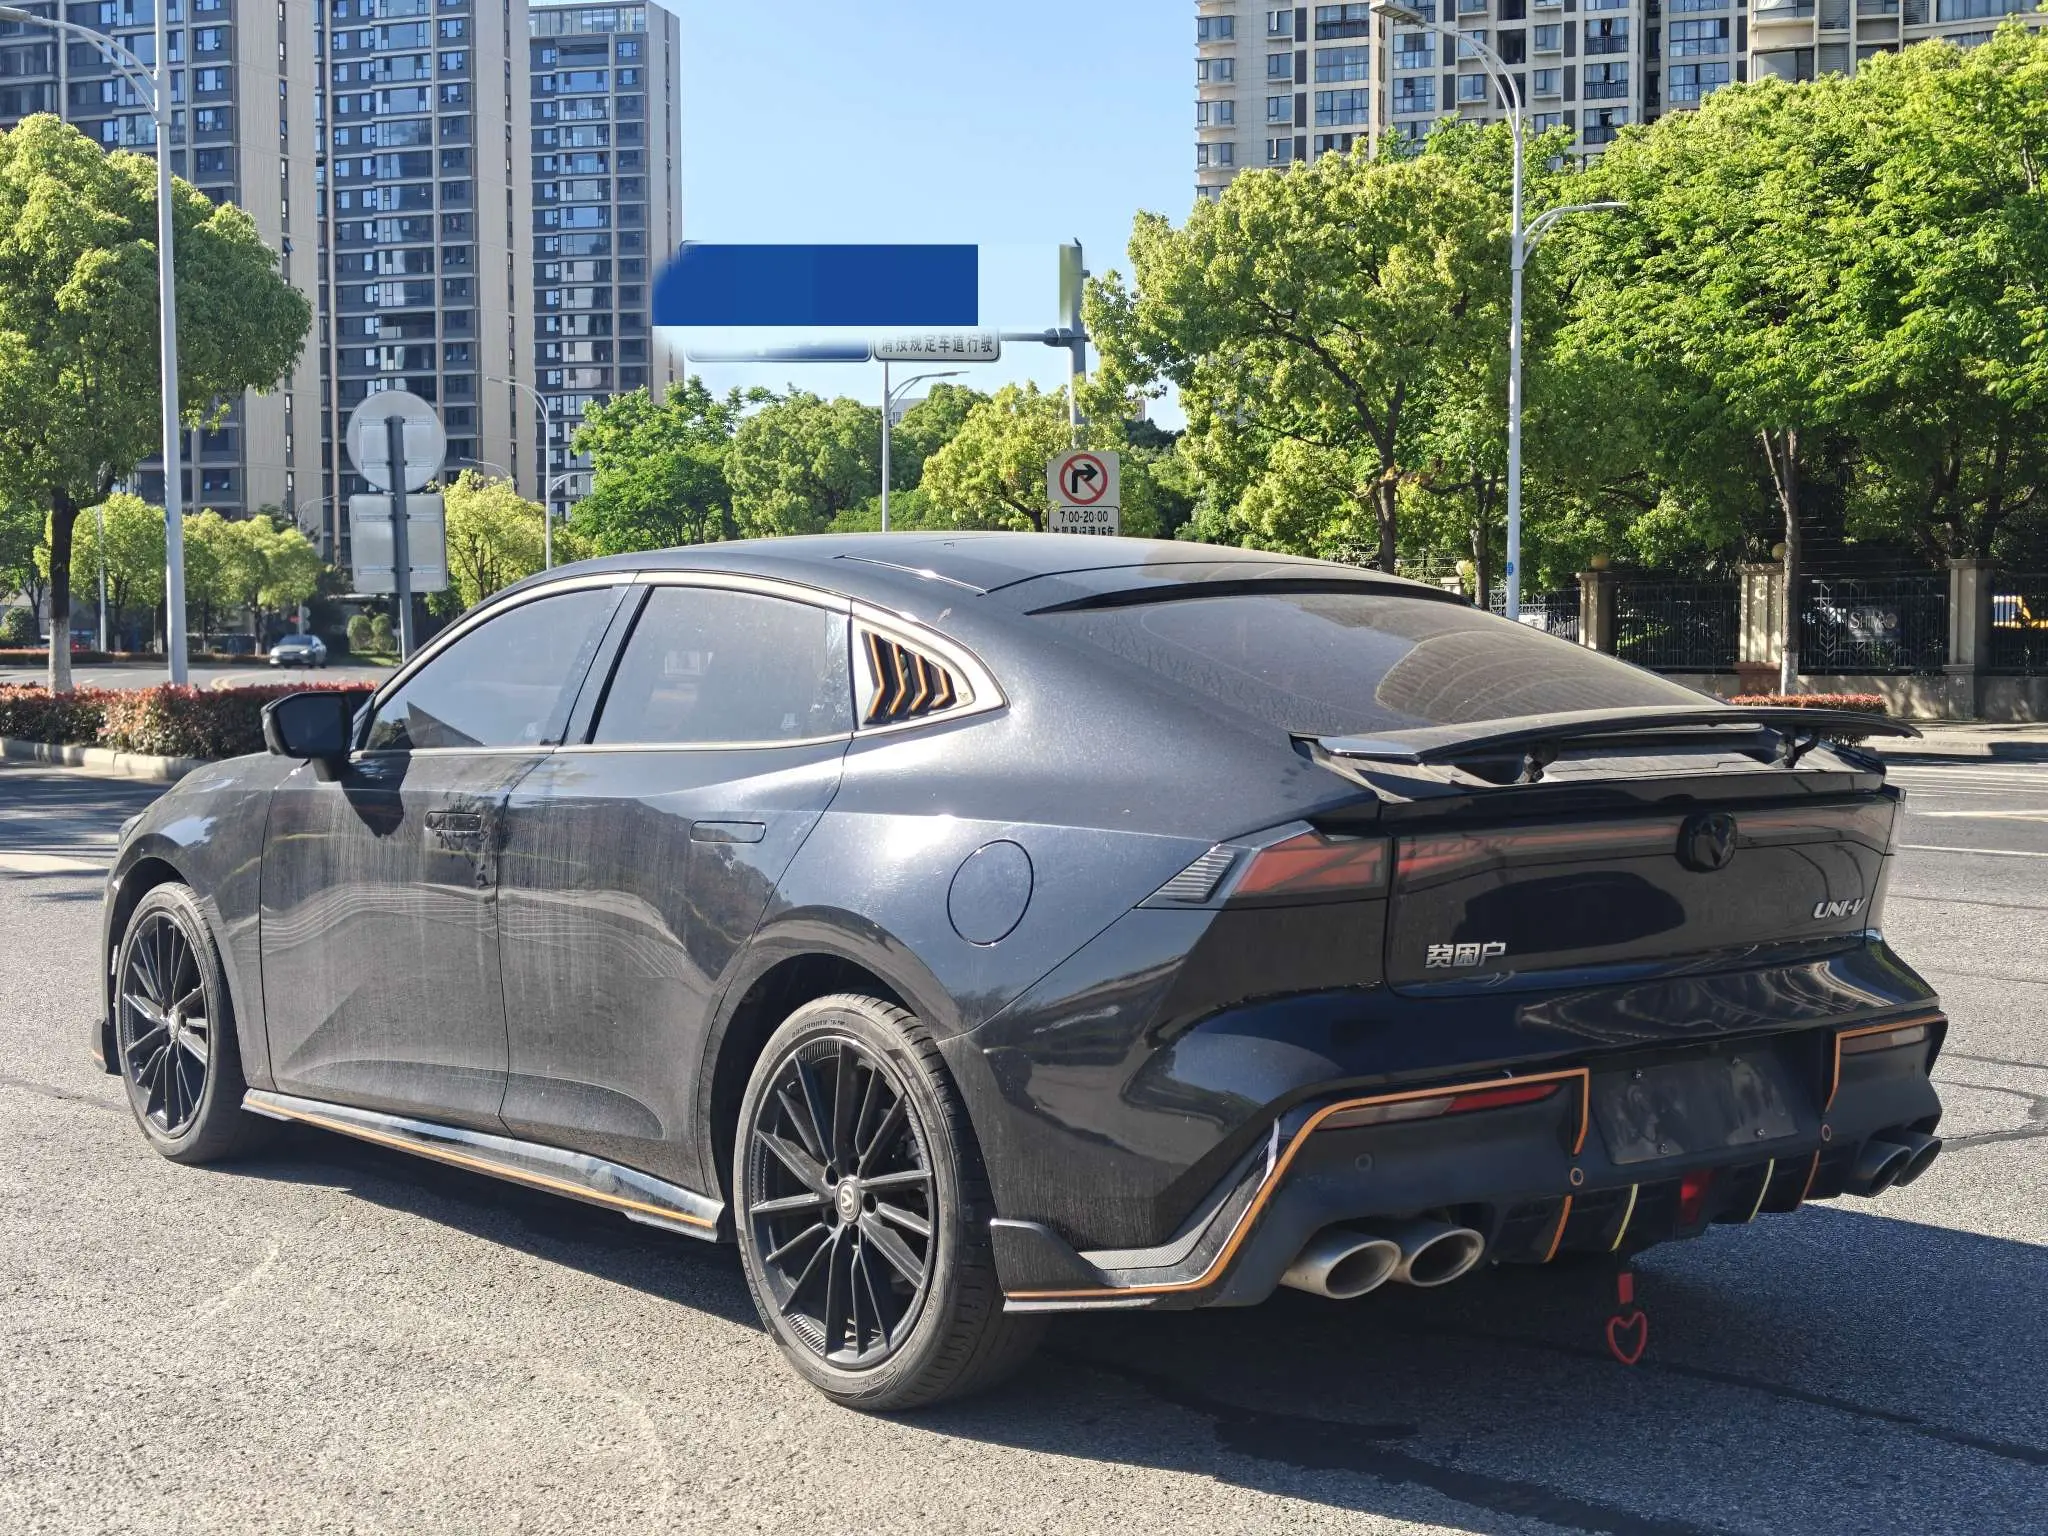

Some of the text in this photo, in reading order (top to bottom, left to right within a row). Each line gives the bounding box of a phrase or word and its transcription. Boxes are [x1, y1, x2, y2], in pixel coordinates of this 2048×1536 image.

[1060, 510, 1109, 523] 7:00-20:00
[1424, 941, 1507, 969] 贫困户
